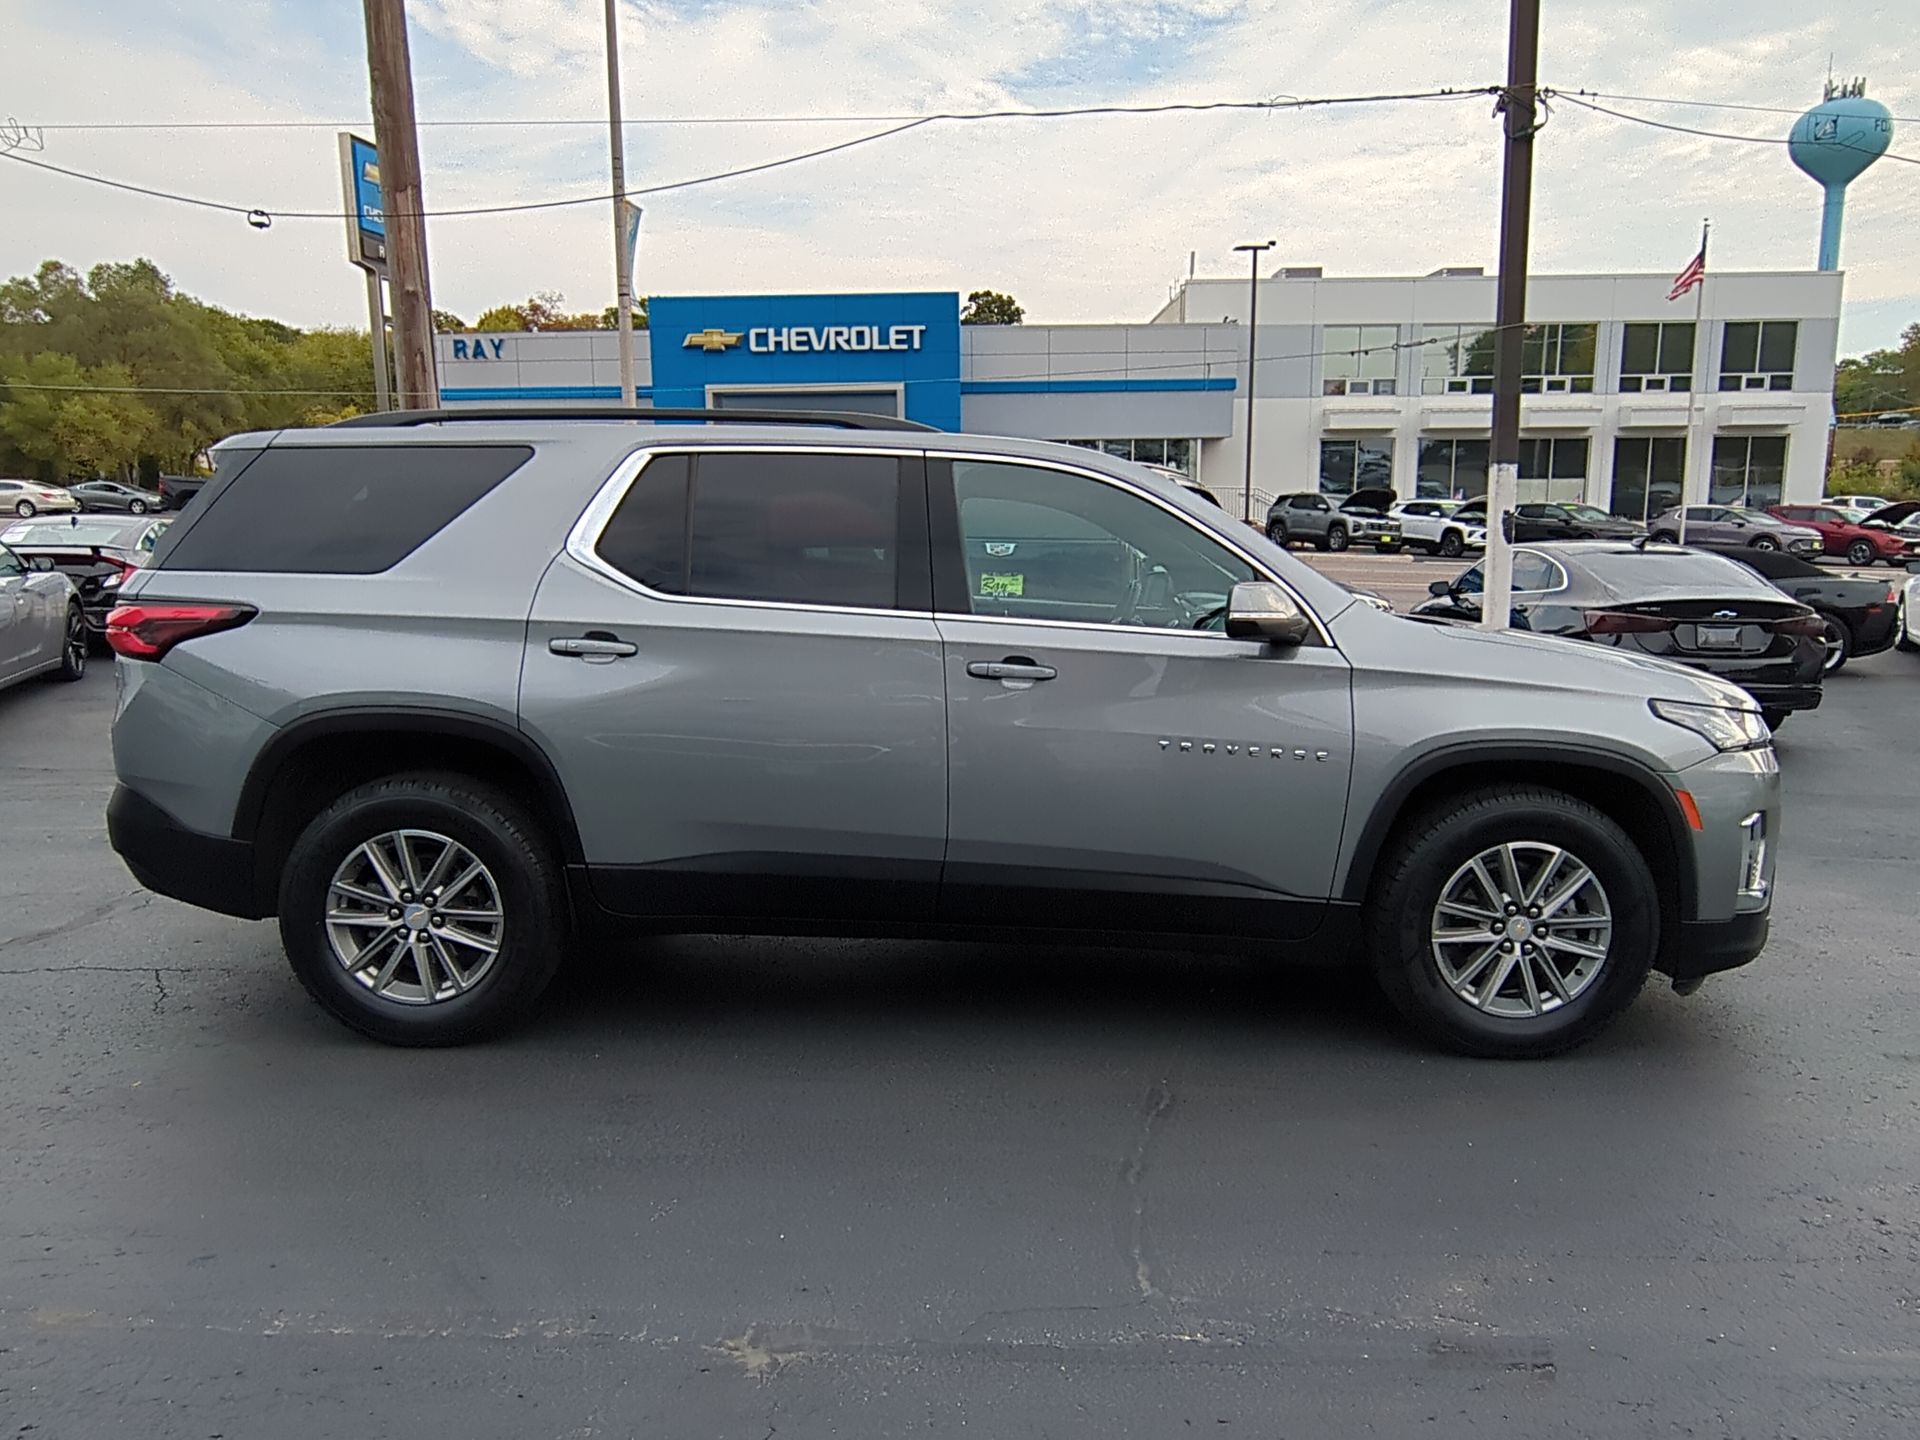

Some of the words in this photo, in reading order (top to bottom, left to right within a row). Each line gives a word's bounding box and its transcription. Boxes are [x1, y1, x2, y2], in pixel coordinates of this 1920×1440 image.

[452, 338, 507, 361] RAY
[748, 325, 926, 353] CHEVROLET
[1157, 740, 1329, 763] TRAVERSE
